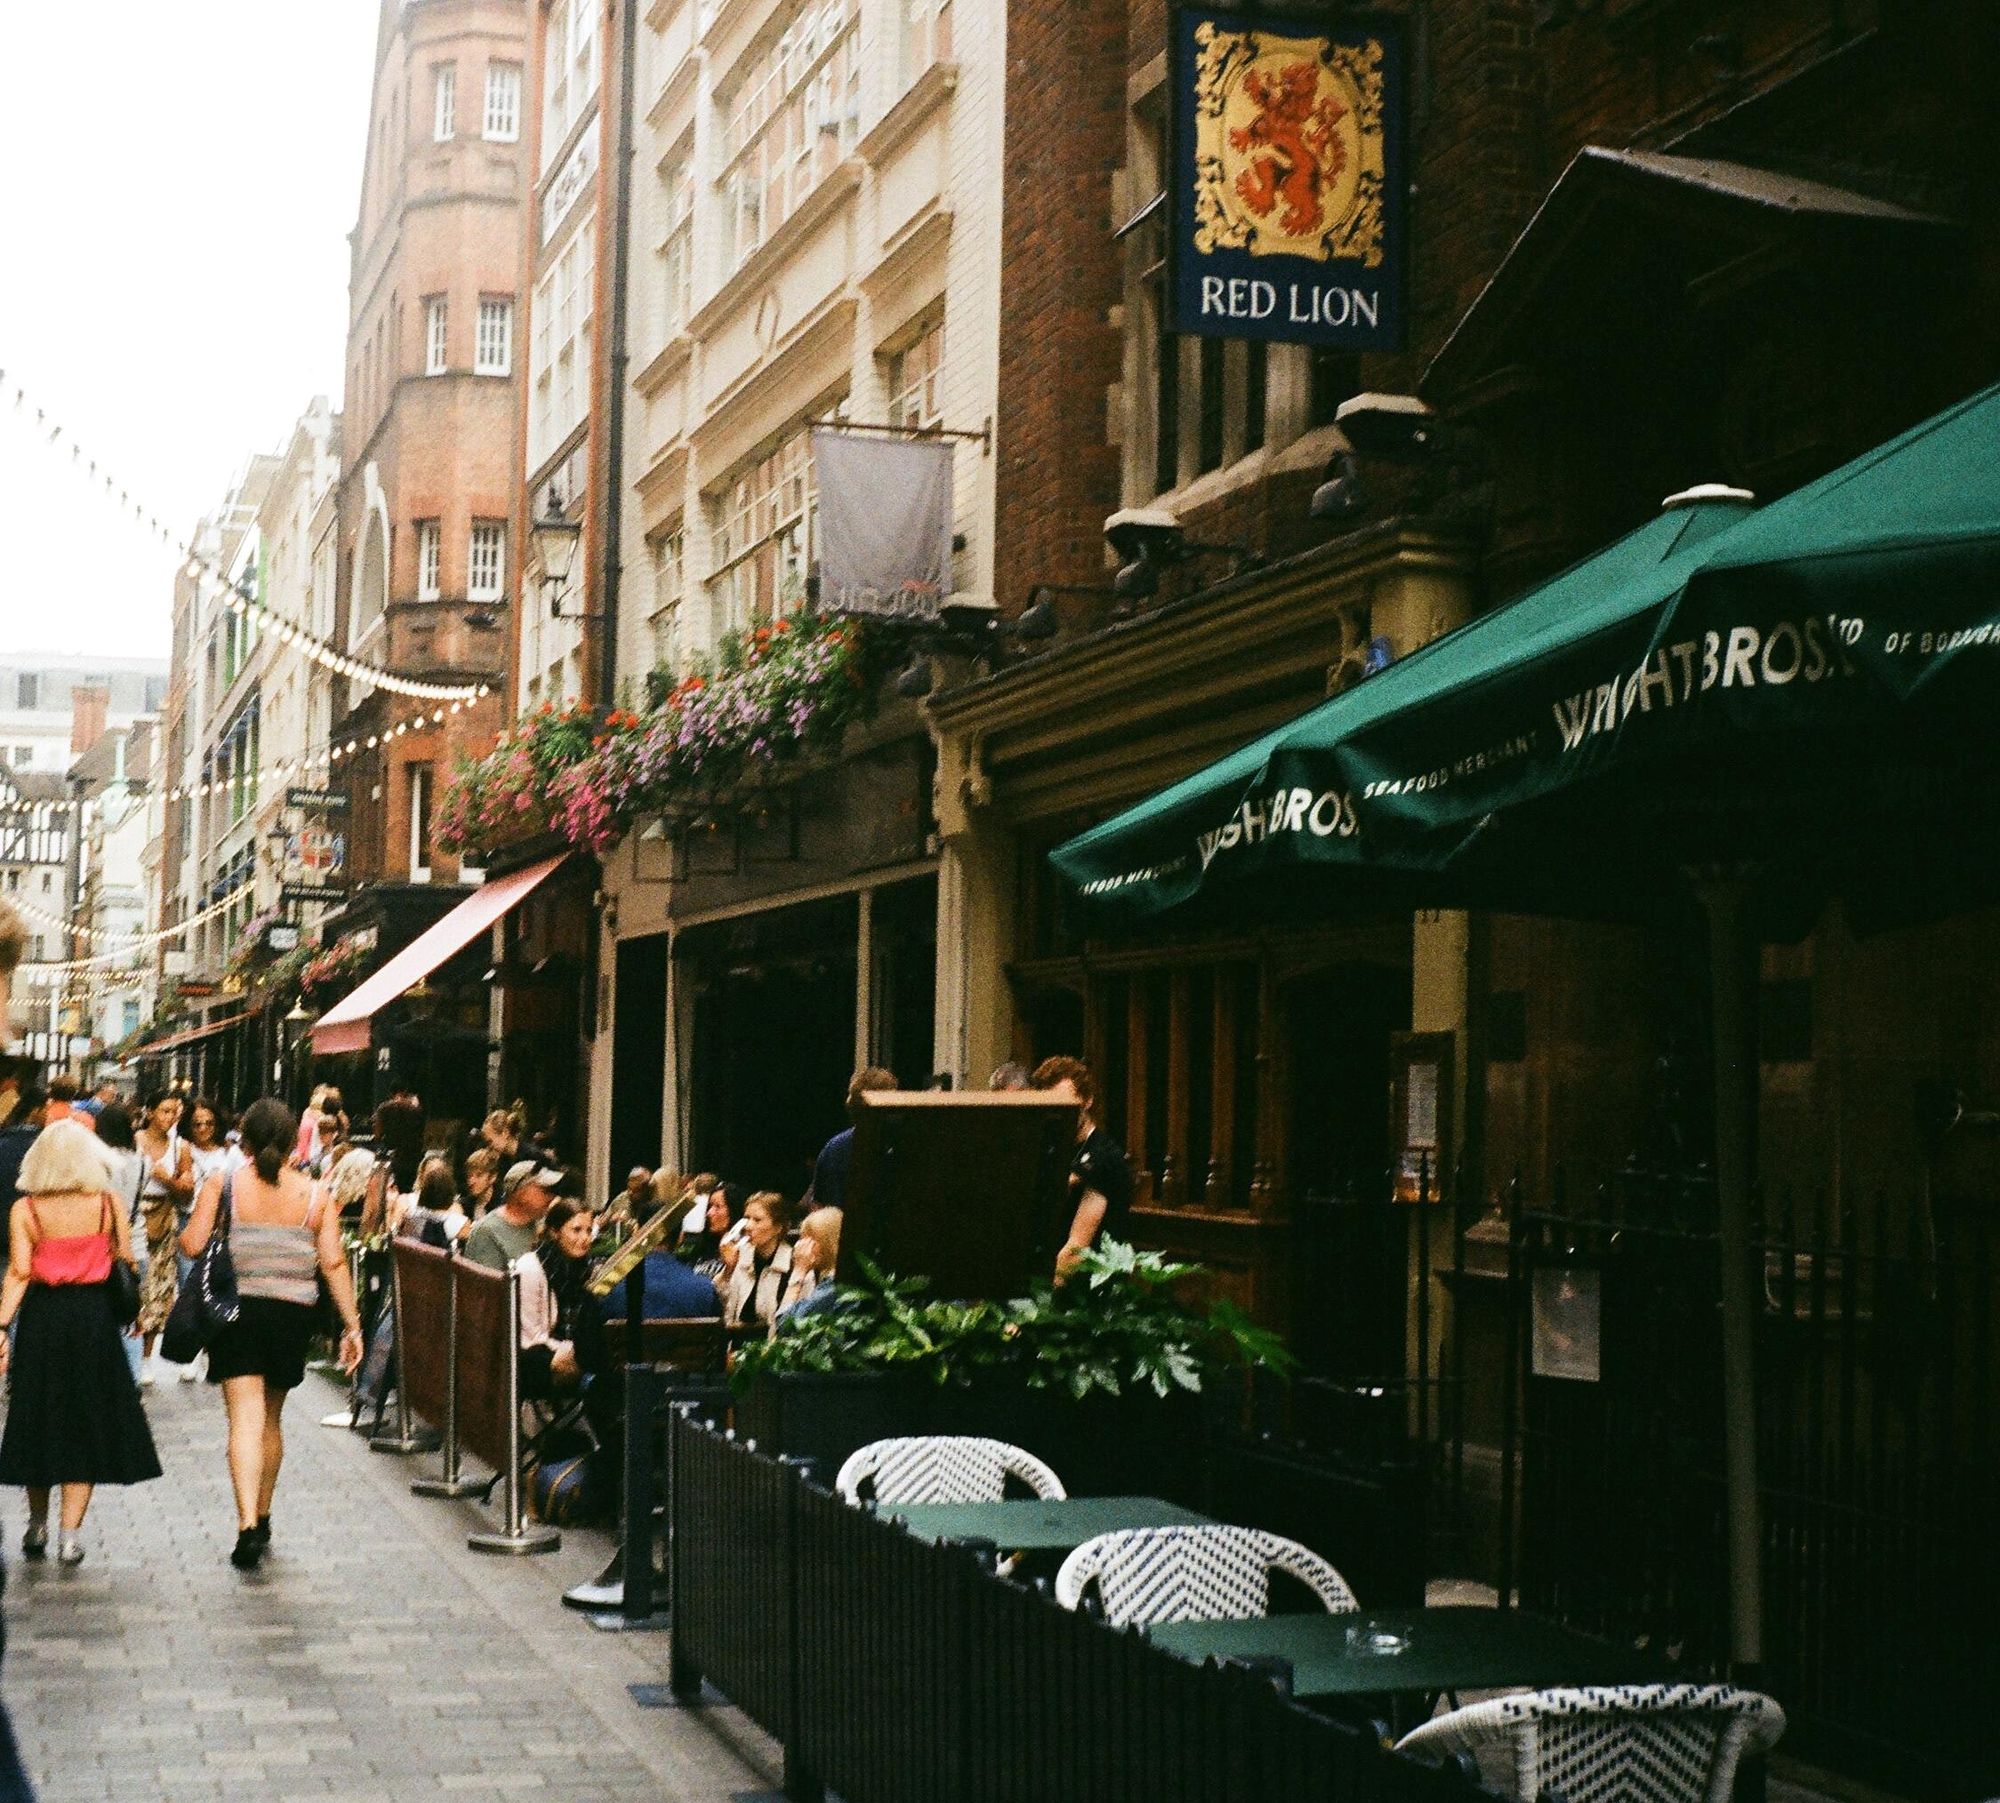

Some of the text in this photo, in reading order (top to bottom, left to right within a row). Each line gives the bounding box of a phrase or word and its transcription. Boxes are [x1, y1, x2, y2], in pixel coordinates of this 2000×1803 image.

[1201, 276, 1378, 328] RED LION
[1884, 631, 1913, 655] OF
[1363, 767, 1449, 800] SEAFOOD
